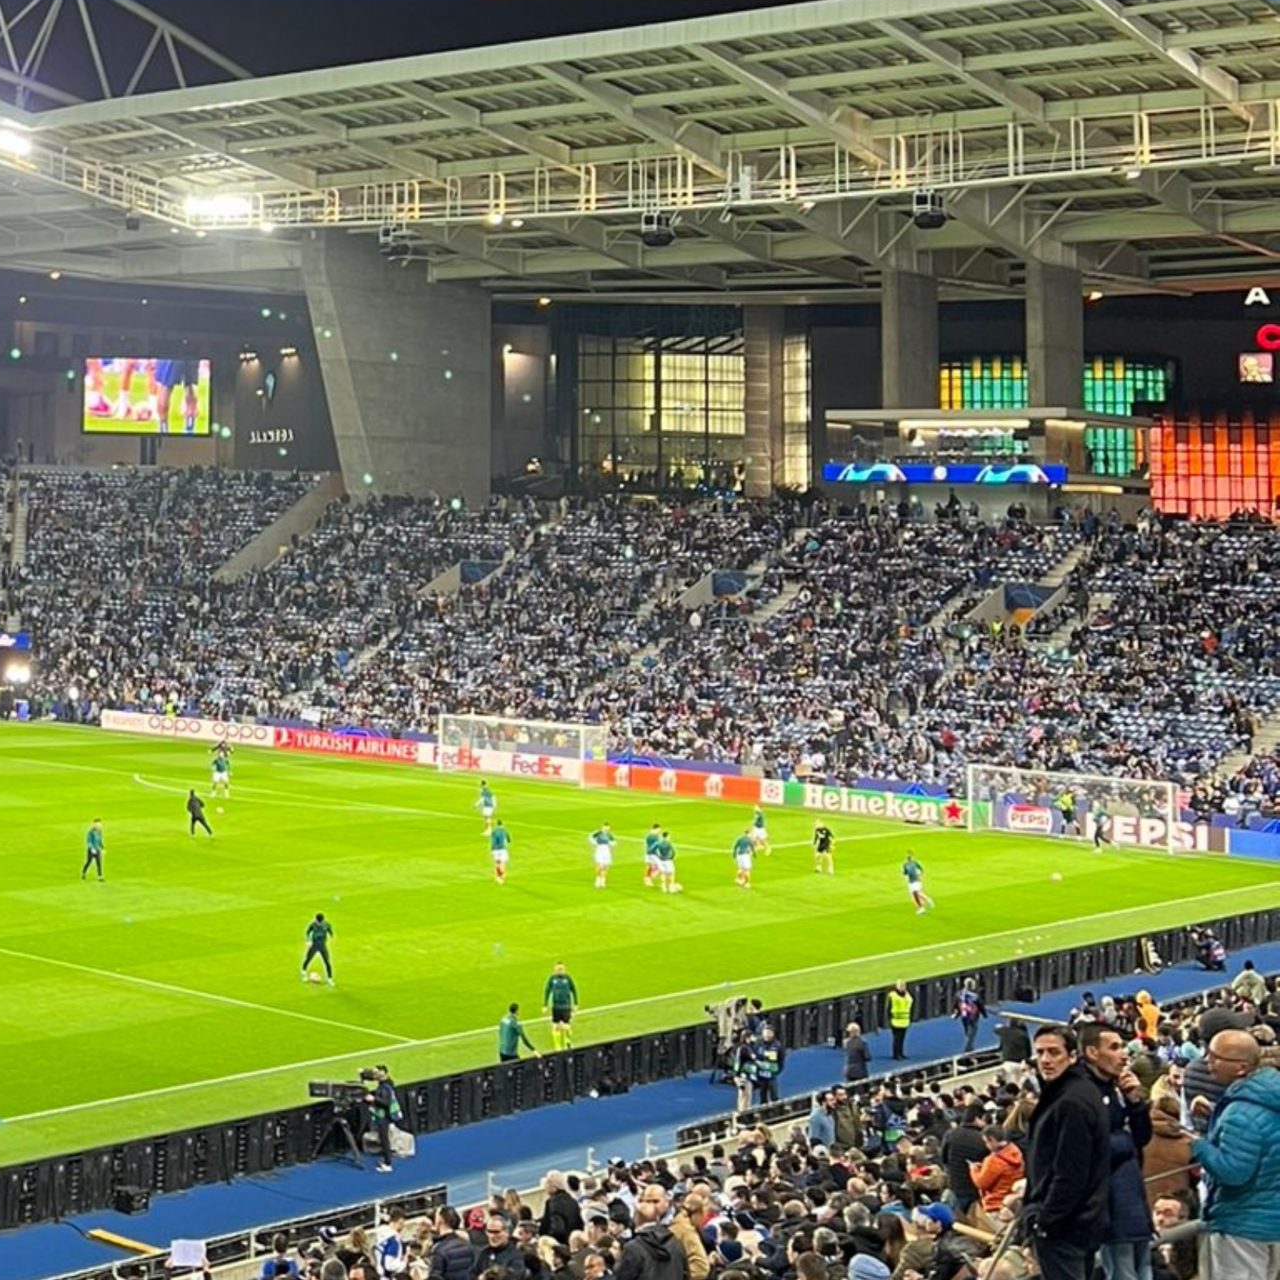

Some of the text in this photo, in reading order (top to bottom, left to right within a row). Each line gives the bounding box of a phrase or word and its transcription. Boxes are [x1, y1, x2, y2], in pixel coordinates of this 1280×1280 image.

[1244, 286, 1270, 306] A
[148, 715, 202, 736] oppo
[212, 722, 268, 741] oppo
[296, 730, 419, 761] TURKISH AIRLINES
[432, 745, 481, 770] FedEx
[511, 753, 562, 778] FedEx
[804, 784, 939, 822] Heineken
[1011, 808, 1051, 828] PEPSI
[1085, 811, 1208, 852] PEPSI
